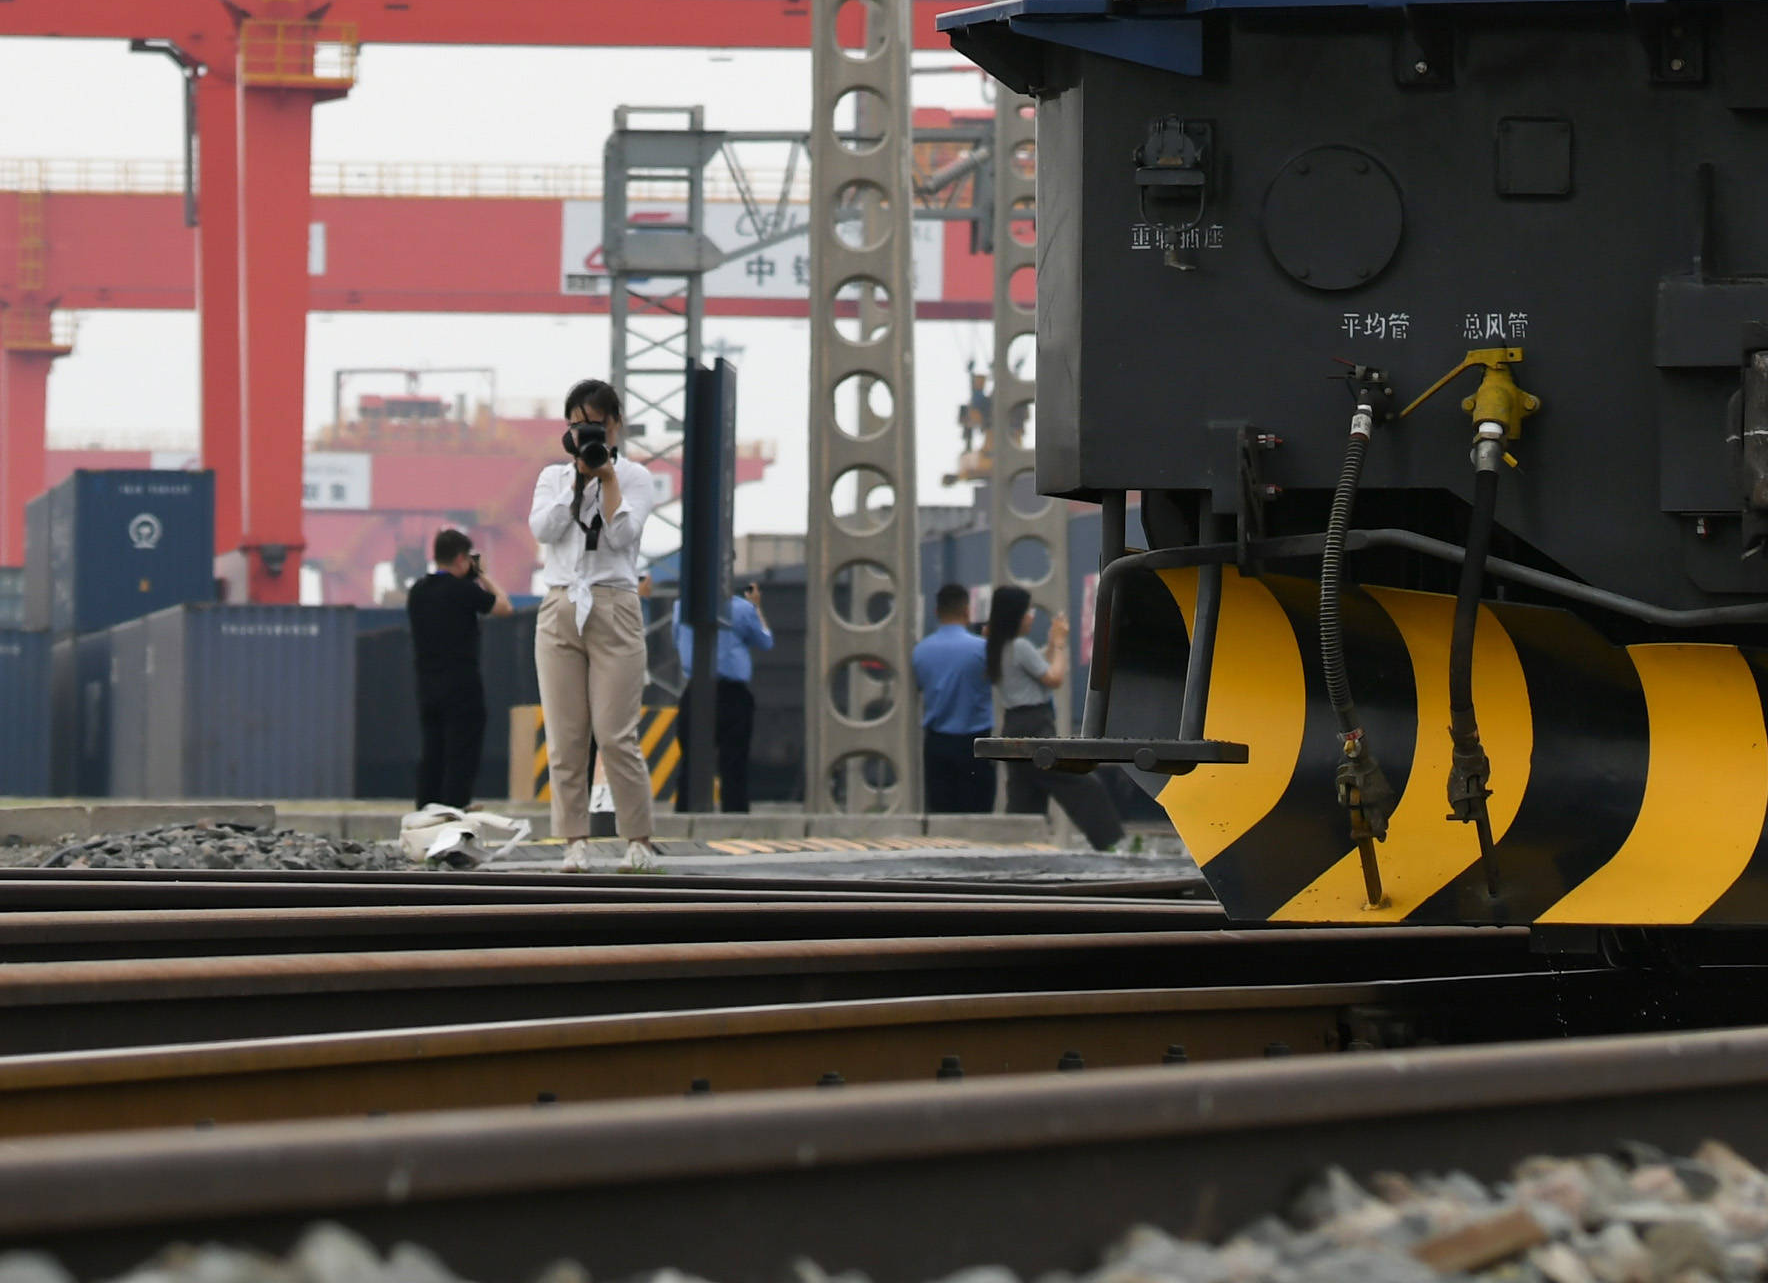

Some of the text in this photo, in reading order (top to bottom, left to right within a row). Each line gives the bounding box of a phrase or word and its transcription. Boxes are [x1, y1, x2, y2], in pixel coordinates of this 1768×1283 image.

[1342, 311, 1529, 339] 平均管 总风管
